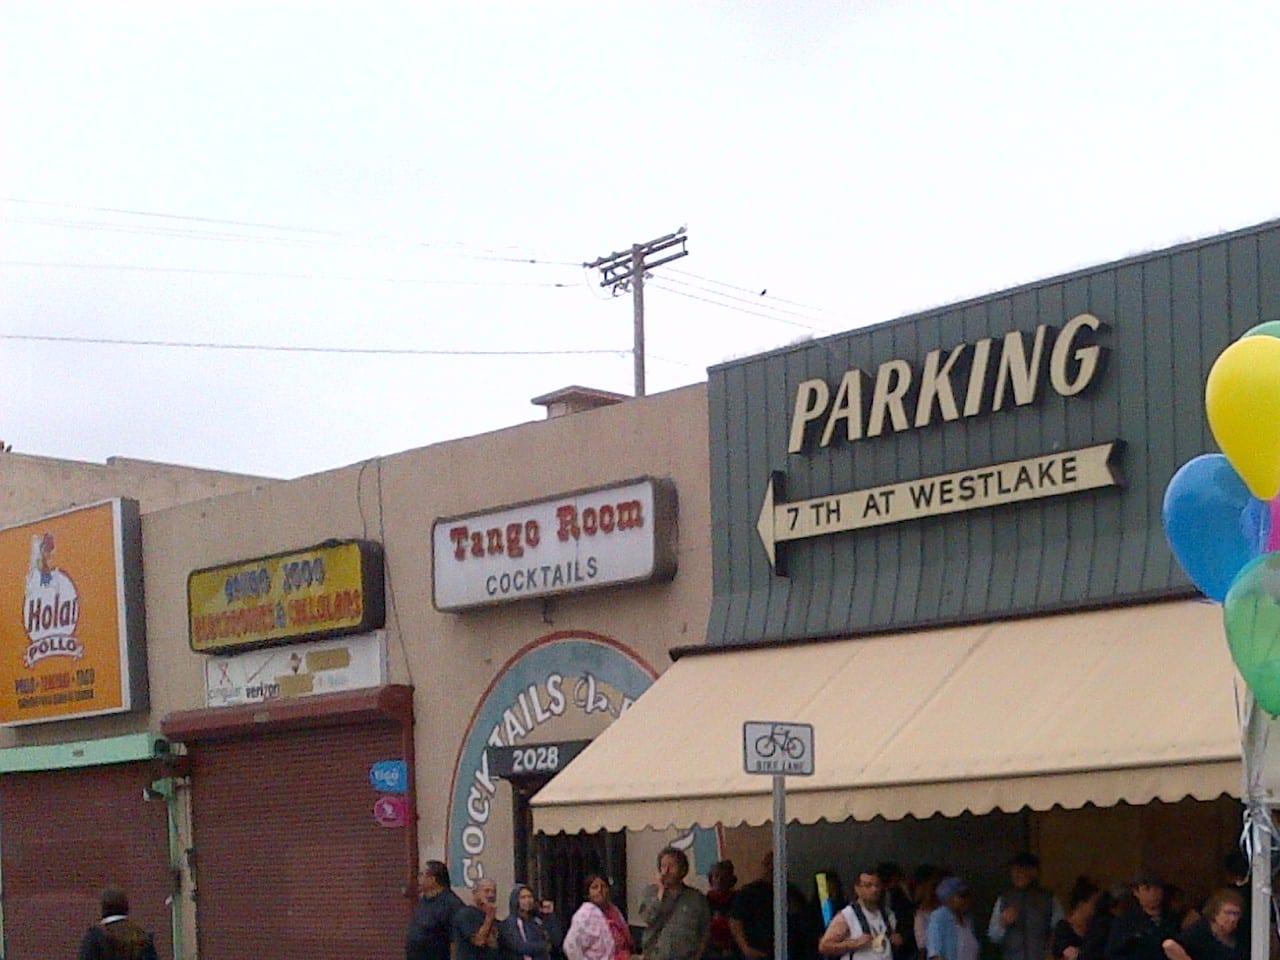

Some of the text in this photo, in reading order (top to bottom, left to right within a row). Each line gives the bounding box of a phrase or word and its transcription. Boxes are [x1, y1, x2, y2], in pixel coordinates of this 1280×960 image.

[788, 313, 1100, 454] PARKING
[787, 457, 1078, 531] 7 TH AT WESTLAKE
[450, 500, 644, 561] Tango Room
[486, 556, 598, 595] COCKTAILS
[28, 594, 76, 632] Hola!
[30, 637, 77, 659] POLLO
[512, 747, 559, 771] 2028
